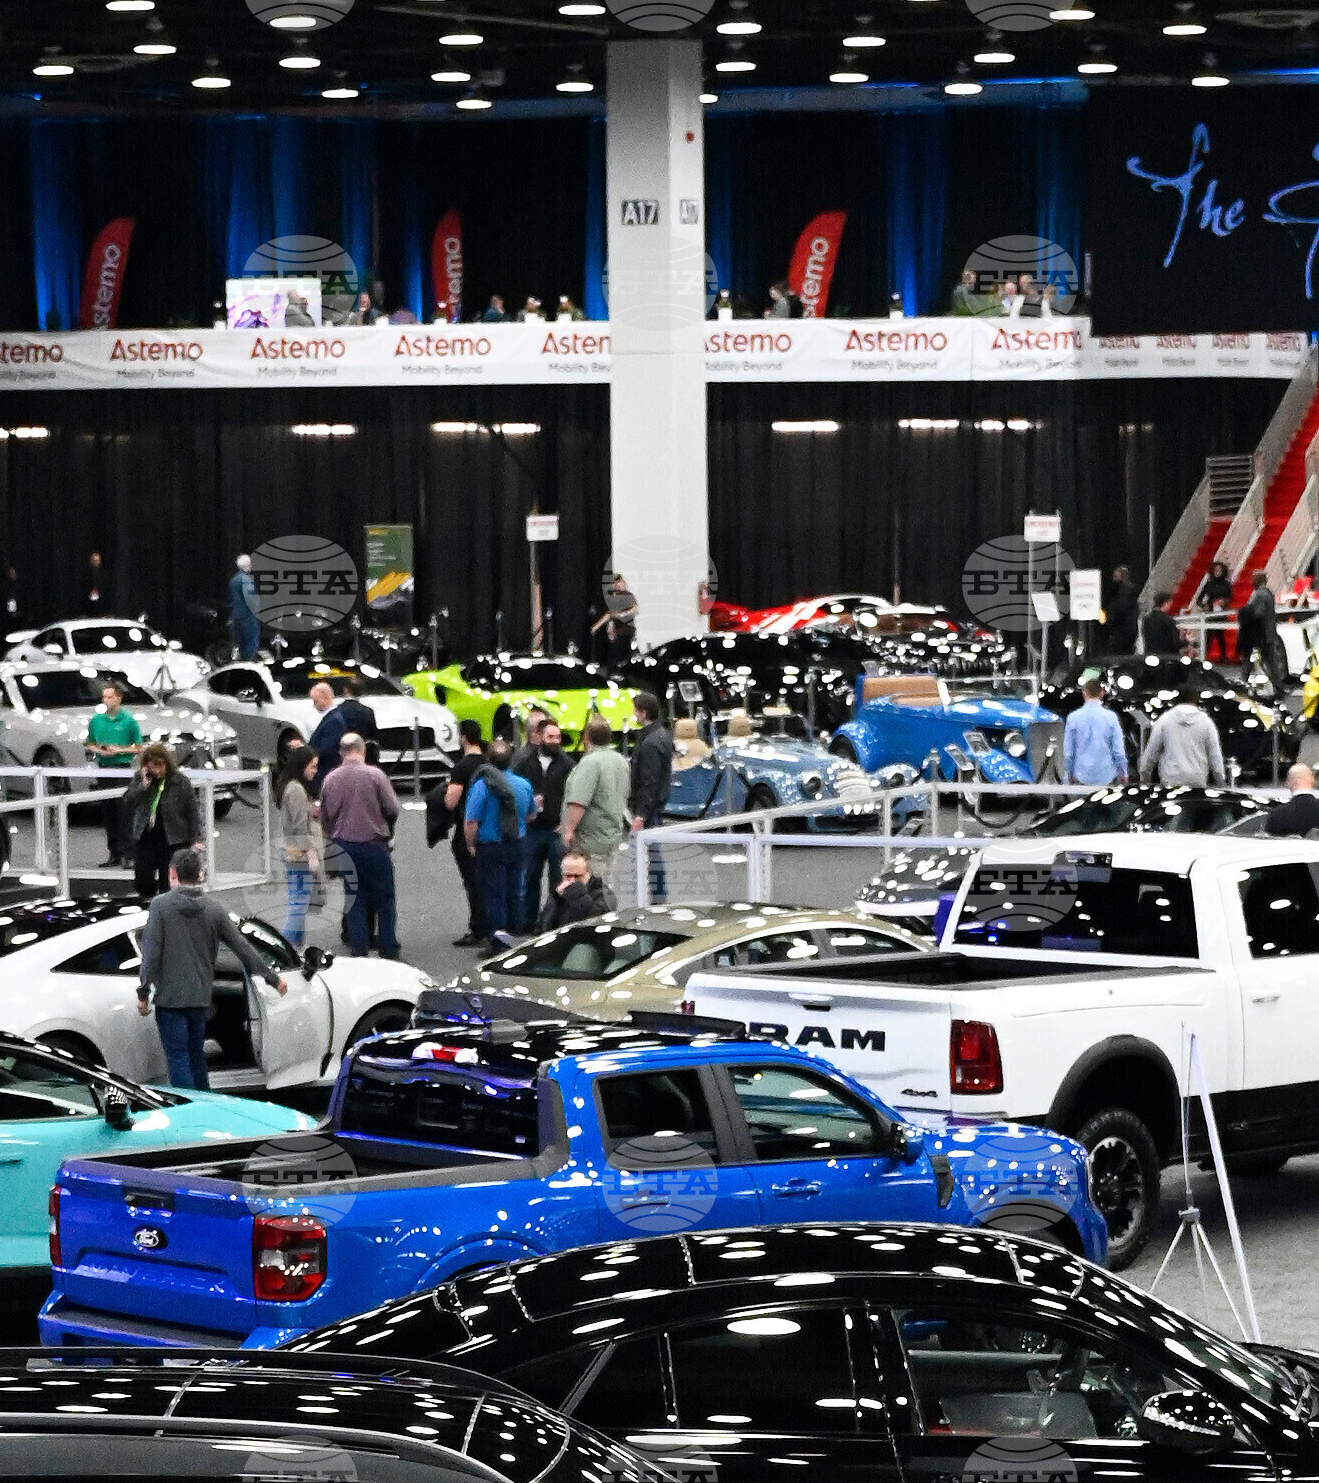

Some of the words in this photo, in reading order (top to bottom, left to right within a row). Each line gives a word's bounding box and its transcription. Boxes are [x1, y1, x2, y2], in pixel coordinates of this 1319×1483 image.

[1126, 121, 1246, 268] The
[624, 201, 657, 225] A17
[93, 243, 121, 331] stemo
[800, 237, 829, 319] stemo
[110, 338, 203, 362] Astemo
[250, 337, 345, 359] Astemo
[394, 334, 492, 357] Astemo
[542, 332, 611, 354] Aste
[704, 331, 792, 353] stemo
[844, 329, 947, 353] Astemo
[749, 1022, 885, 1051] RAM
